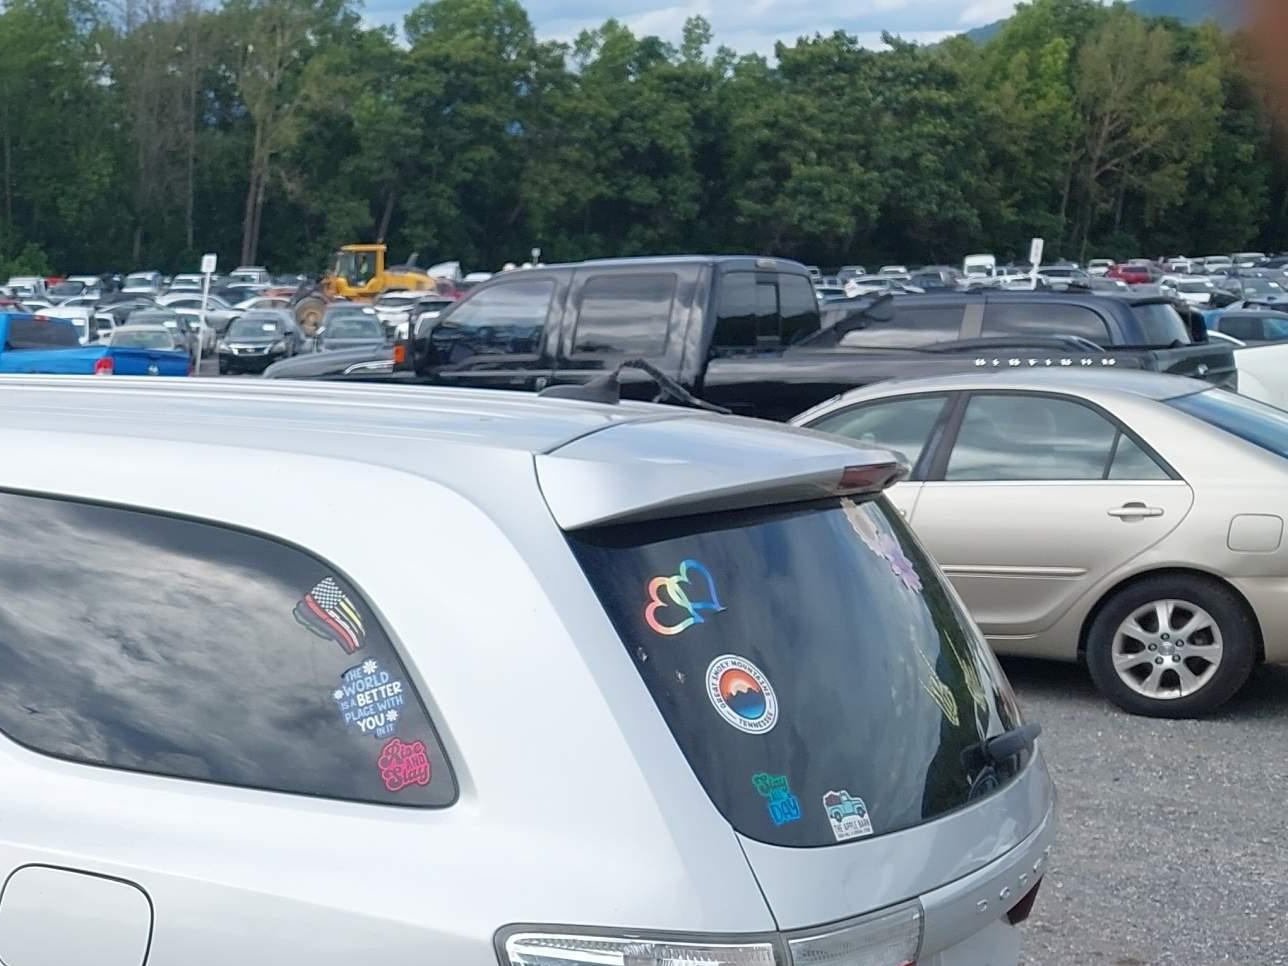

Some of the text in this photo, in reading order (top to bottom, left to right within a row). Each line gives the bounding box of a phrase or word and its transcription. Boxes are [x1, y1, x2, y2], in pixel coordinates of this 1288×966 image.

[342, 671, 390, 697] WORLD
[345, 667, 363, 683] THE
[356, 681, 403, 708] BETTER
[344, 695, 404, 724] PLACE WITH
[356, 713, 386, 733] YOU
[770, 799, 800, 823] DAY
